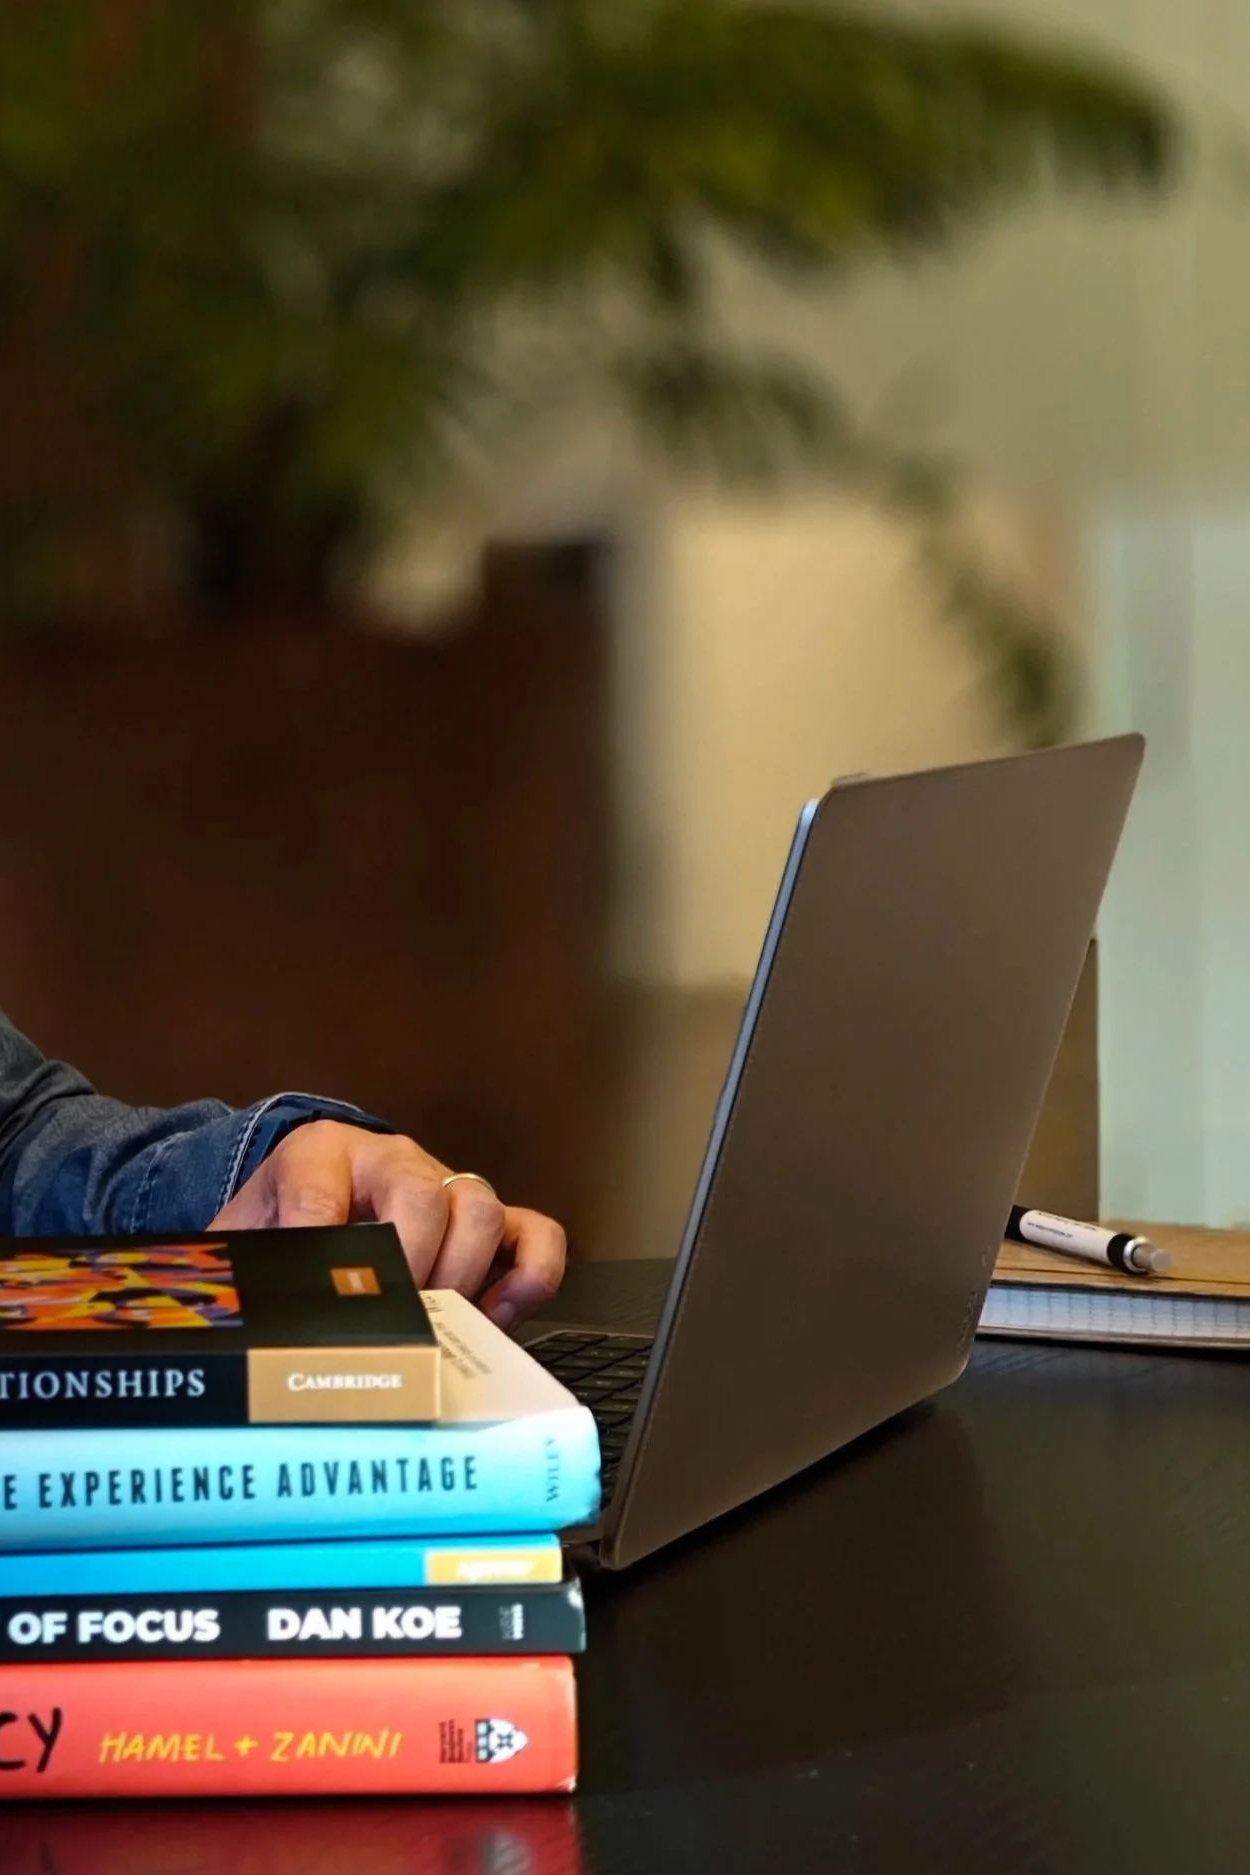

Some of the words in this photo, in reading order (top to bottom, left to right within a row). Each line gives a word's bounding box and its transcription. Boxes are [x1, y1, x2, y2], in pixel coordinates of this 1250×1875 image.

[38, 1464, 256, 1509] EXPERIENCE
[277, 1455, 478, 1499] ADVANTAGE
[545, 1436, 561, 1503] WILEY
[8, 1611, 68, 1645] OF
[76, 1608, 221, 1645] FOCUS
[267, 1605, 363, 1642] DAN
[371, 1604, 463, 1640] KOE
[98, 1733, 226, 1763] HAMEL
[269, 1728, 402, 1763] ZANINI
